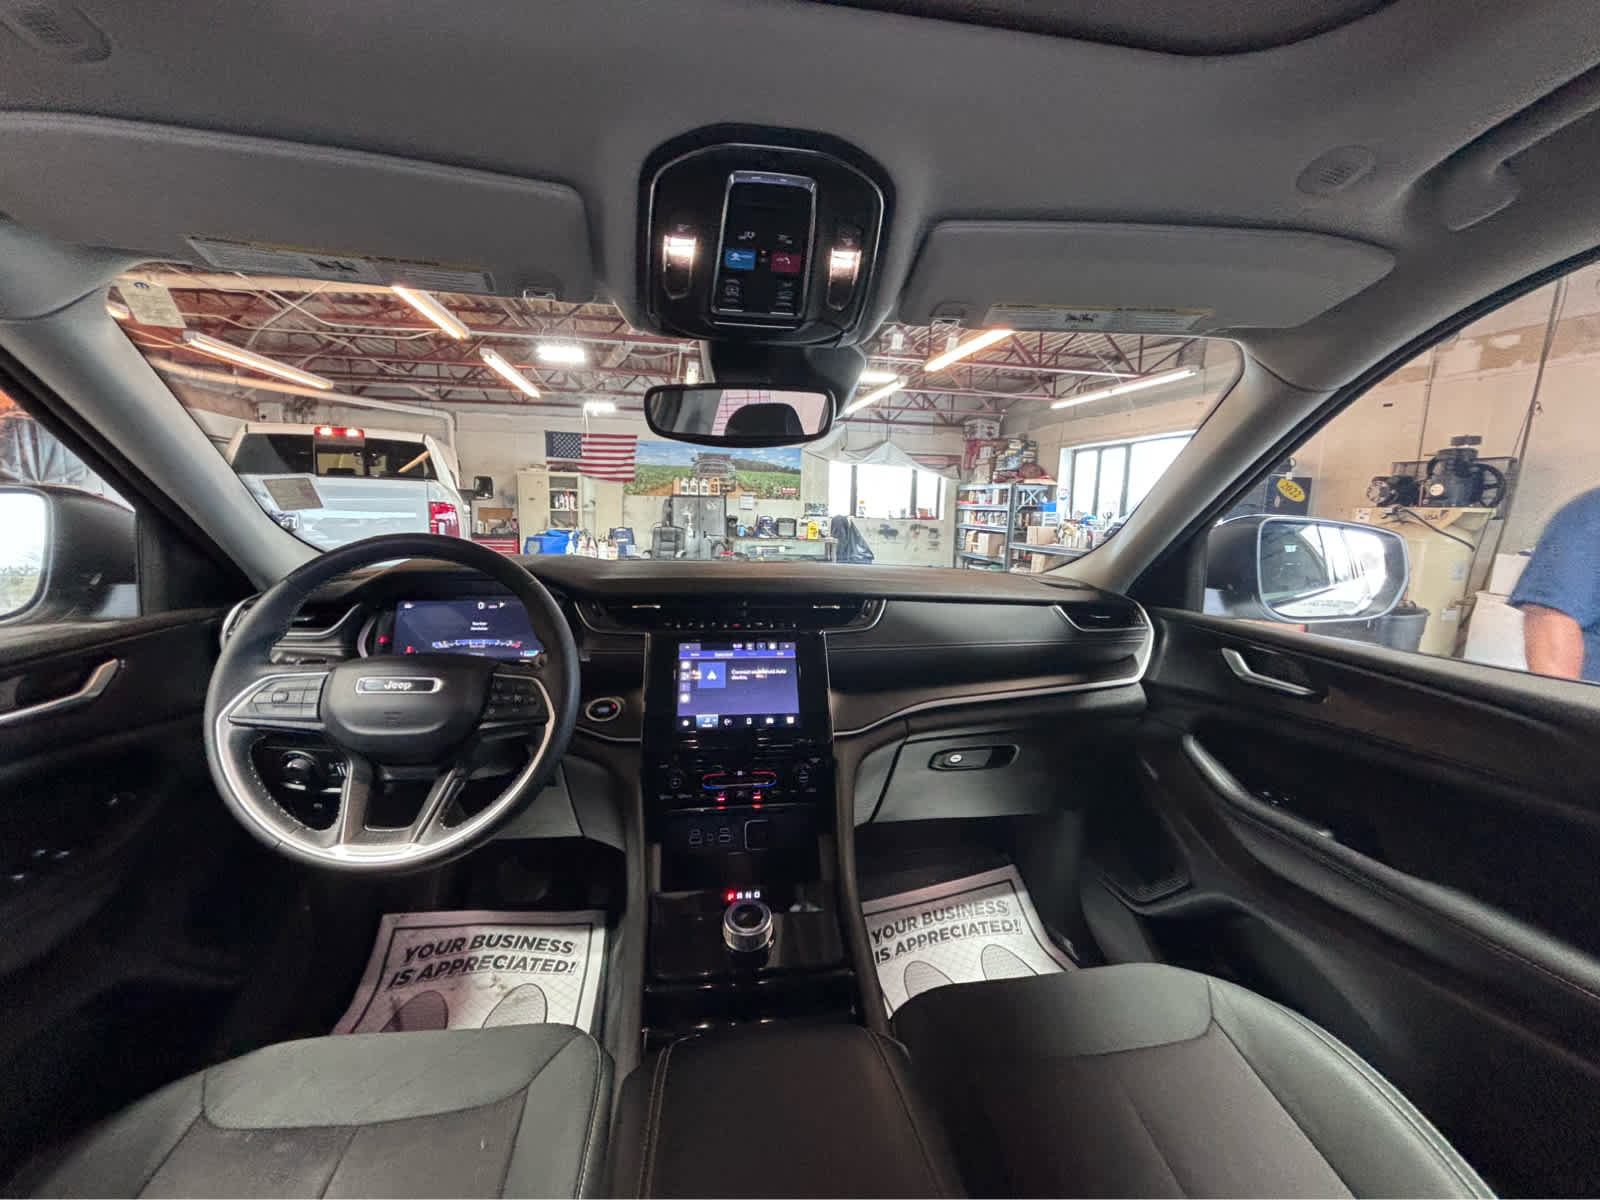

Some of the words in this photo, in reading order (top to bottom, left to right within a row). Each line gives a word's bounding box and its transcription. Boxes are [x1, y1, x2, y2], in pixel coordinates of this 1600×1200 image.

[384, 680, 412, 691] Jeep
[872, 917, 917, 945] YOUR
[922, 900, 1008, 926] BUSINESS
[405, 937, 466, 962] YOUR
[469, 933, 575, 954] BUSINESS
[874, 946, 891, 964] IS
[895, 919, 1021, 957] APPRECIATED!
[388, 970, 414, 989] IS
[416, 954, 577, 983] APPRECIATED!
